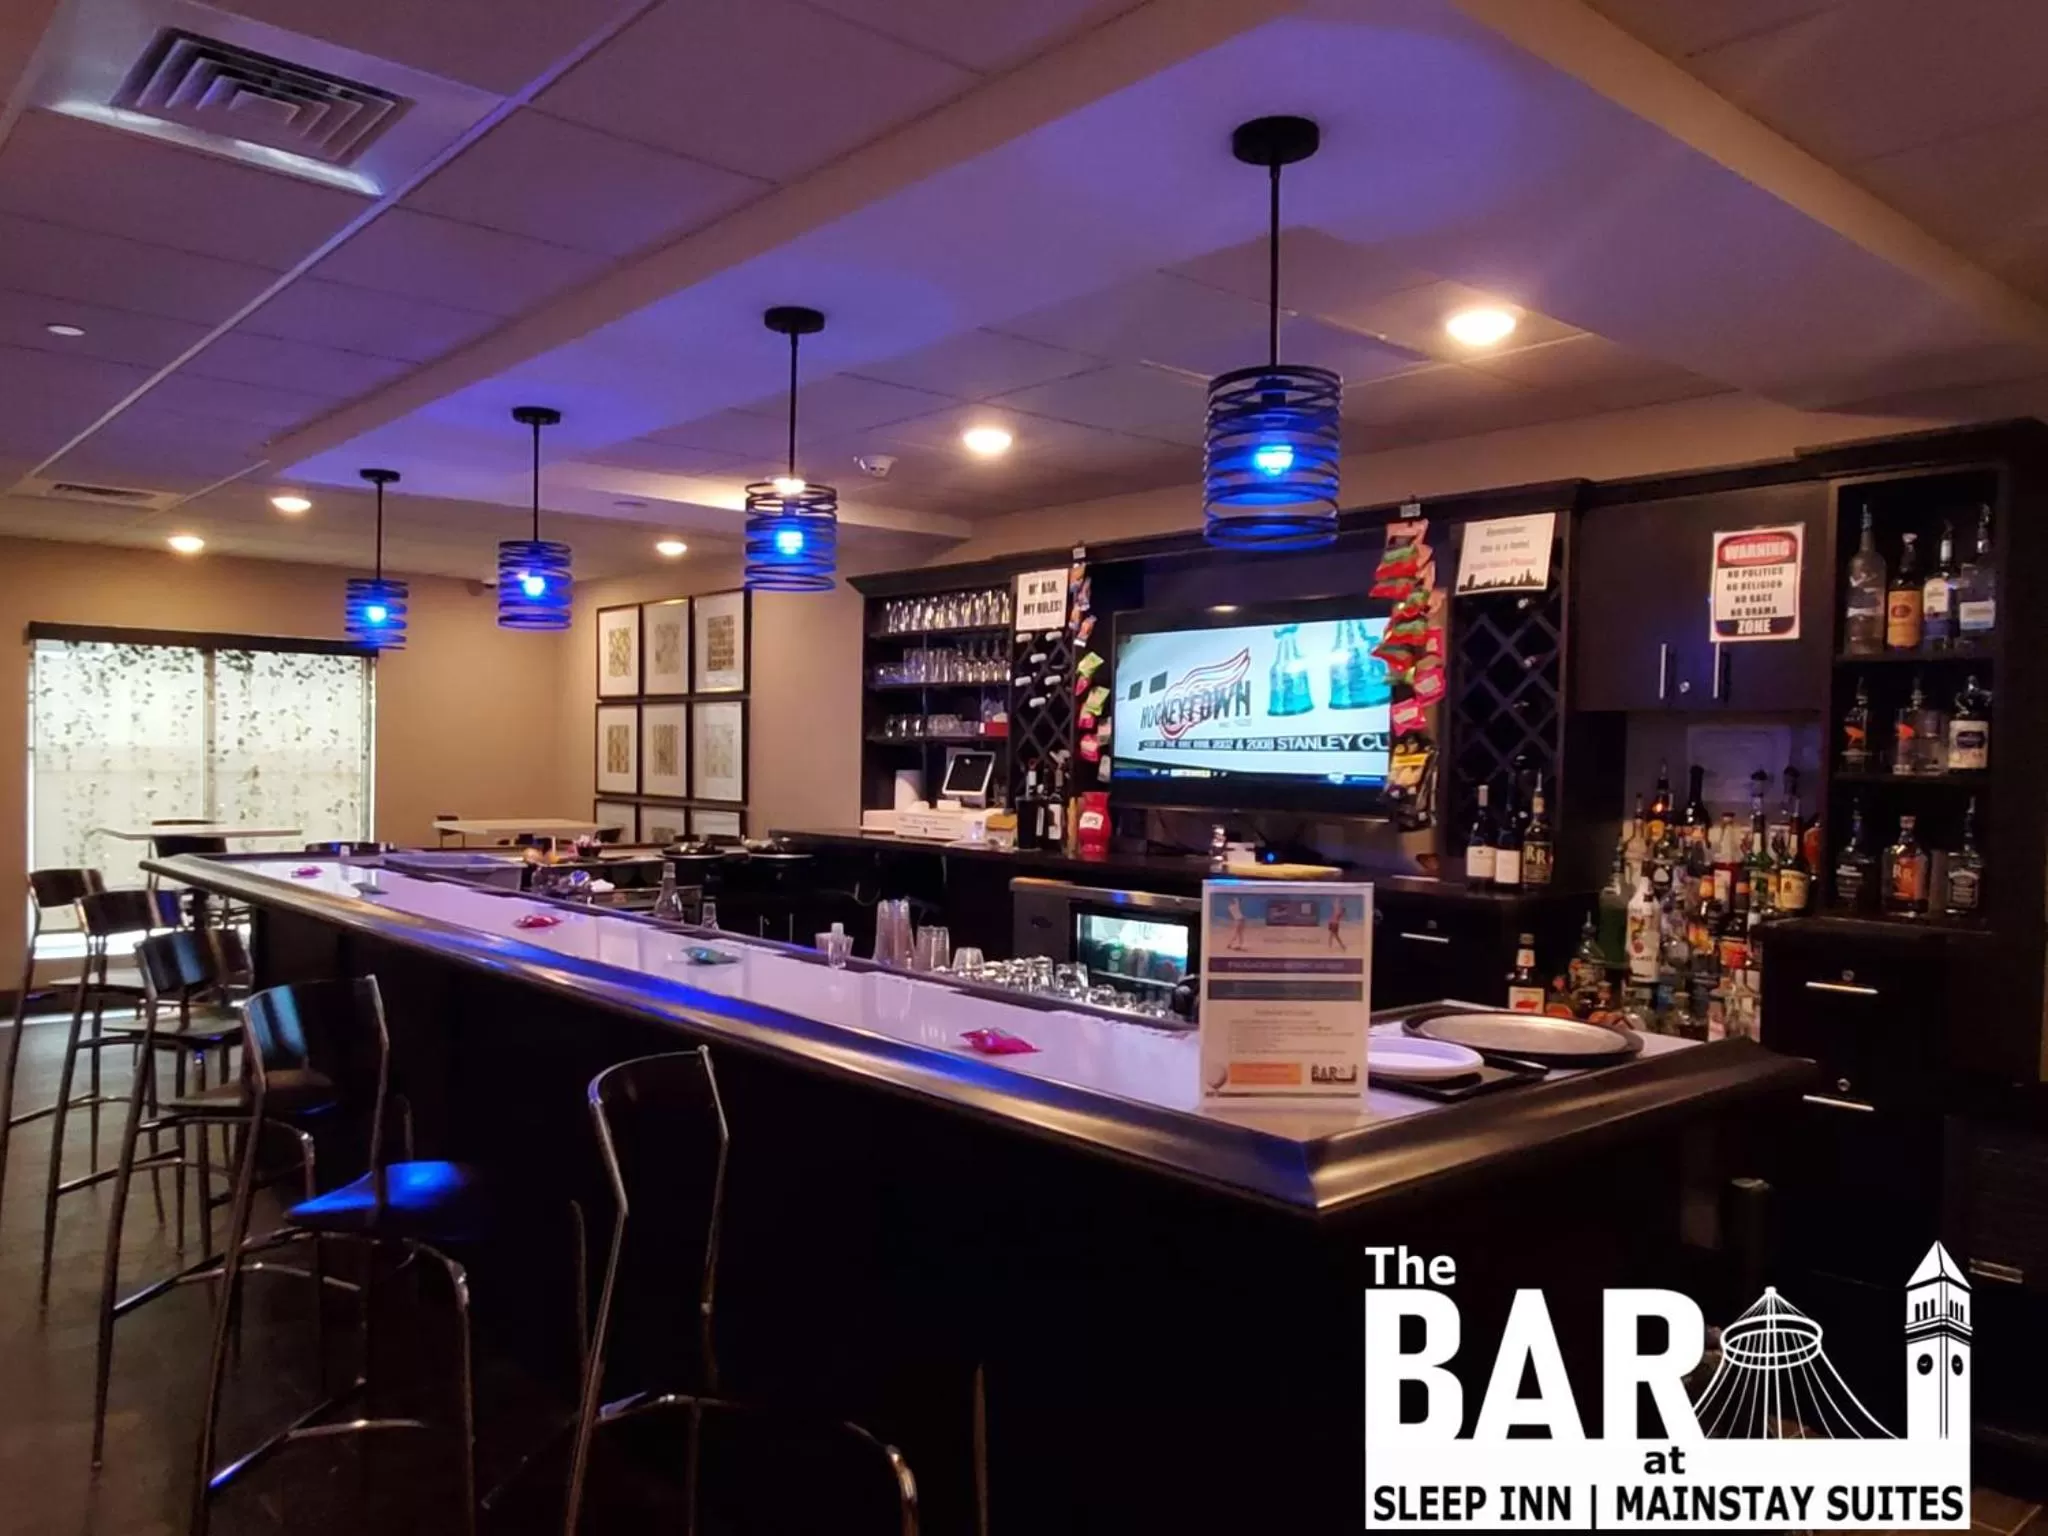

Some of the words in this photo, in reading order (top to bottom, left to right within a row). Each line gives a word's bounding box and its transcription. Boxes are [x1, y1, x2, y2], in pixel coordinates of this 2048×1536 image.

[1724, 541, 1790, 561] WARNING
[1727, 569, 1740, 578] NO
[1742, 567, 1784, 577] POLITICS
[1726, 583, 1738, 591] NO
[1740, 580, 1783, 590] RELIGION
[1735, 595, 1747, 603] NO
[1749, 593, 1773, 602] RACE
[1730, 608, 1742, 616] NO
[1745, 606, 1777, 616] DRAMA
[1737, 619, 1771, 634] ZONE
[1277, 735, 1354, 750] STANLEY
